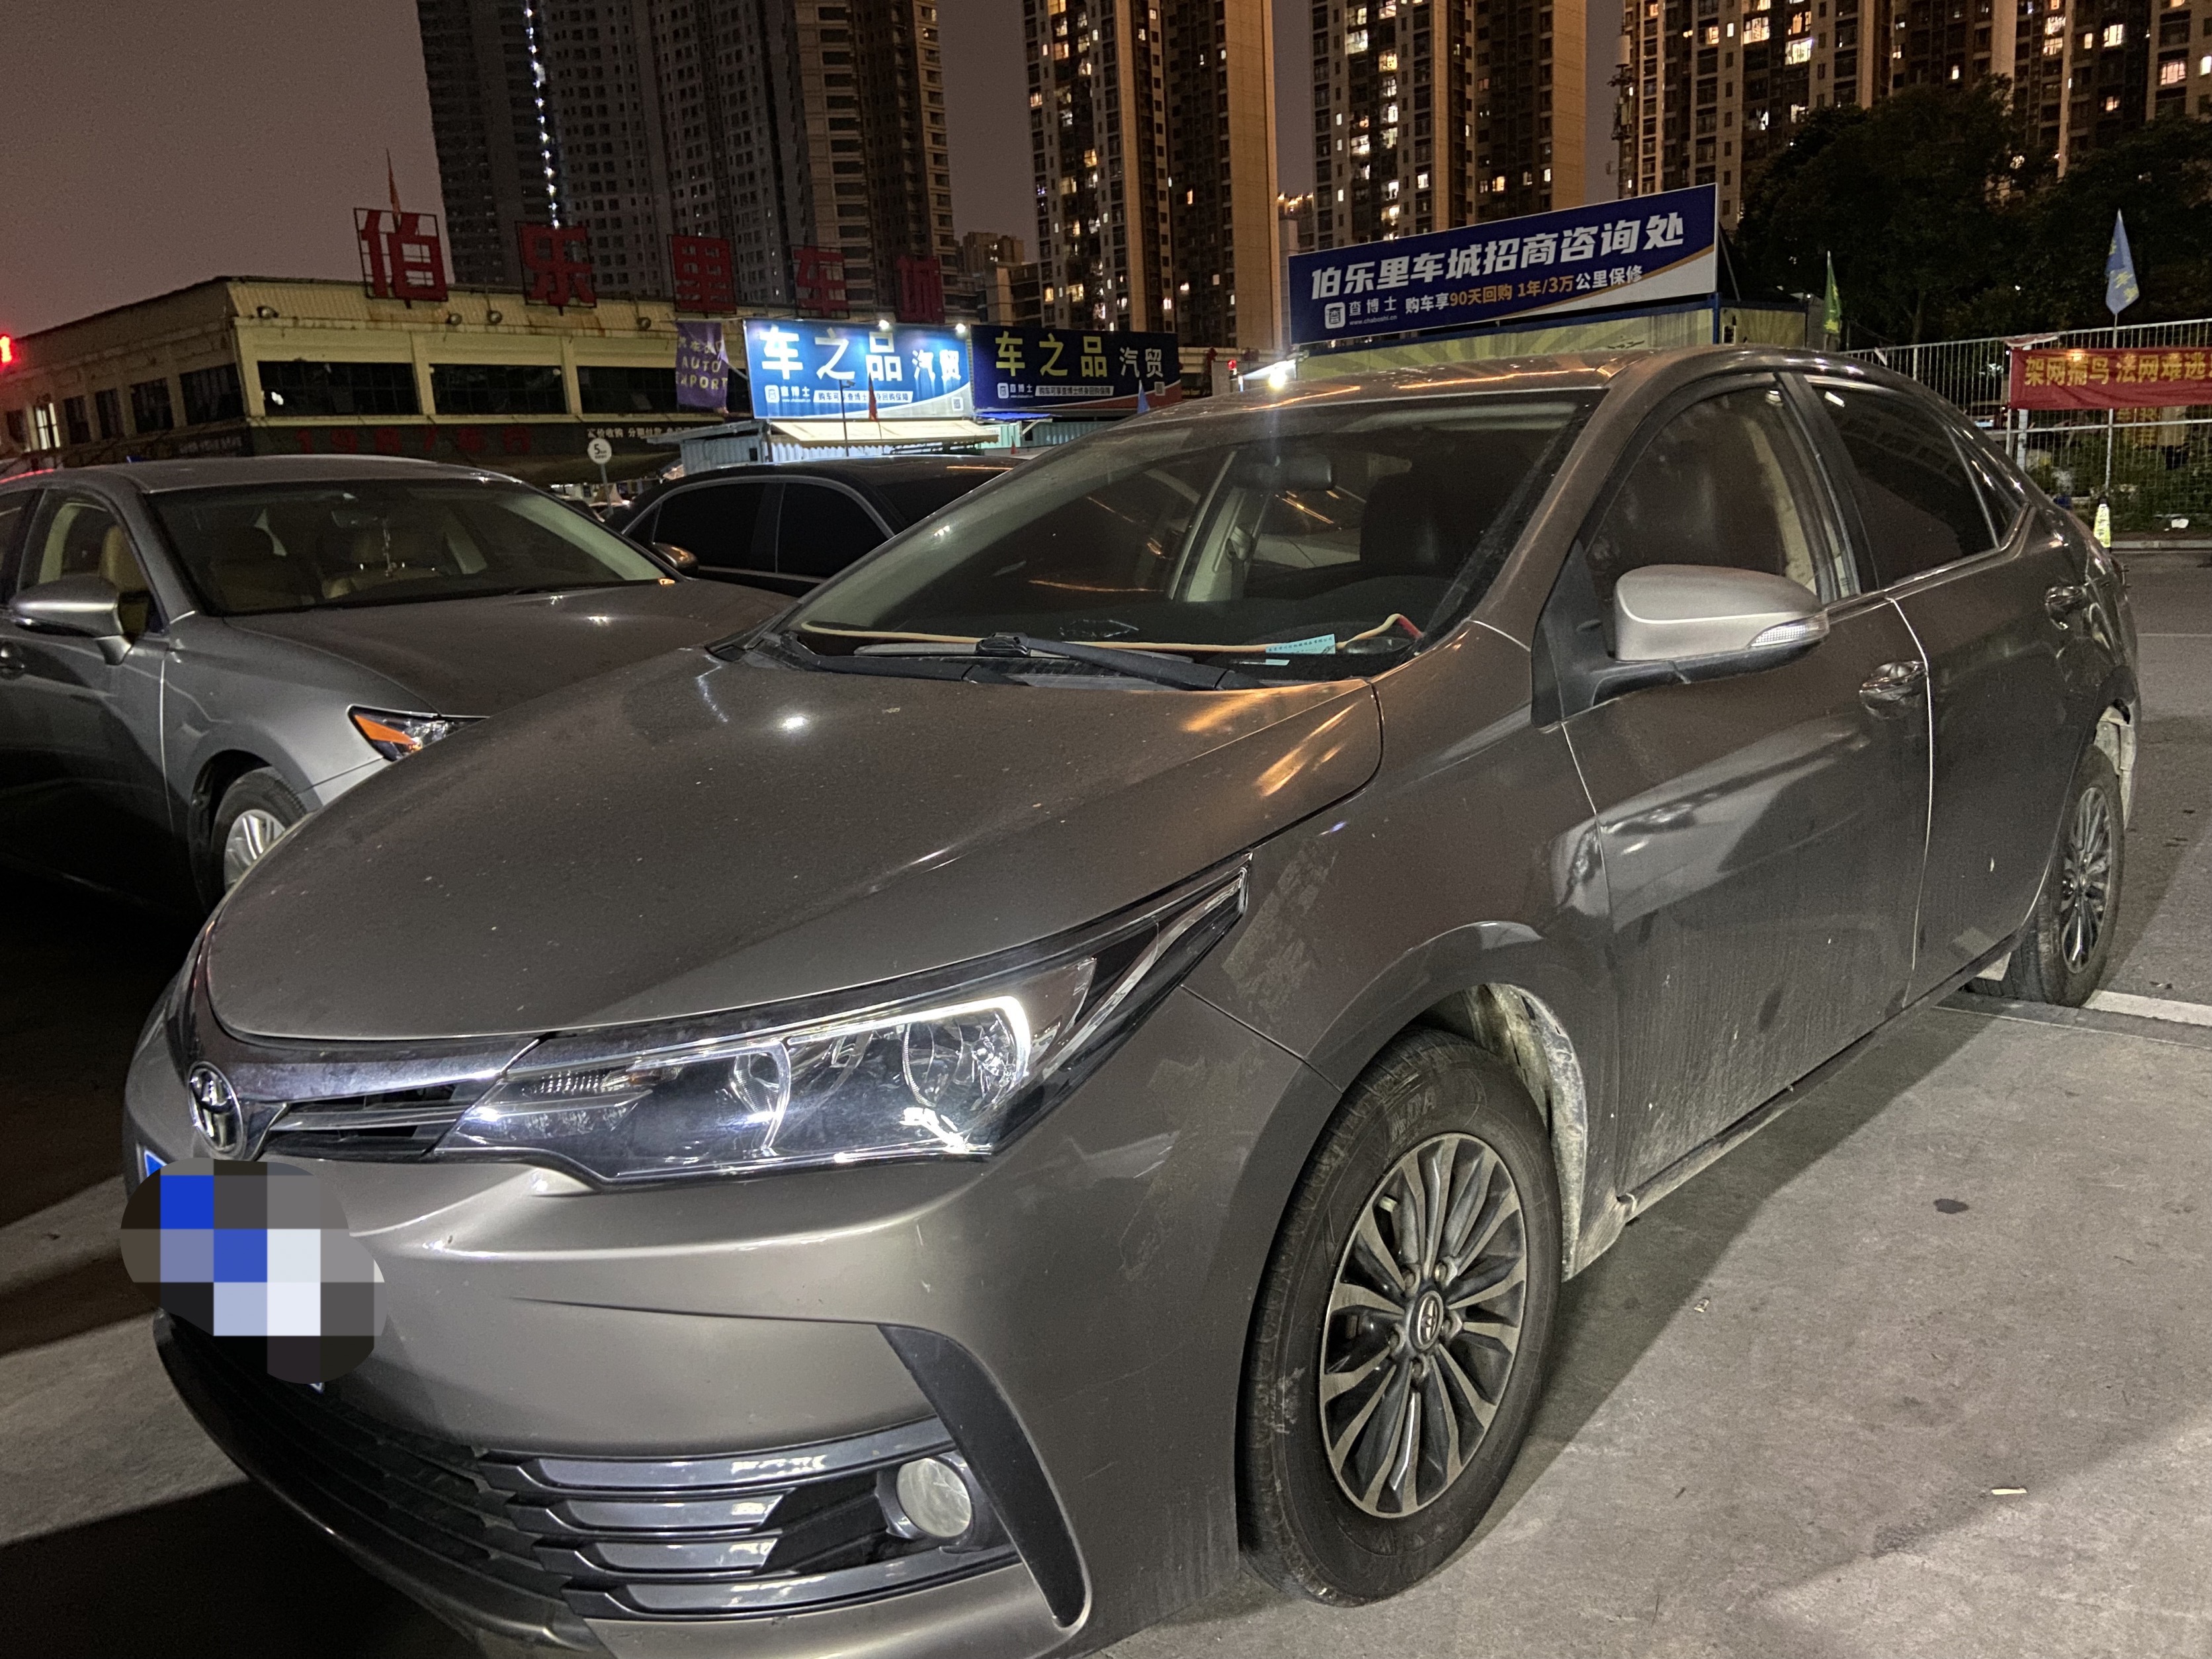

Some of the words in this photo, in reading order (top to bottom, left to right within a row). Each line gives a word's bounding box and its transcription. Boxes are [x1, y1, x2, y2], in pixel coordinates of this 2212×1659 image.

[1310, 212, 1684, 300] 伯乐里车城招商咨询处
[1405, 284, 1512, 314] 购车享90天回购
[1517, 265, 1643, 298] 1年/3万公里保修
[1348, 296, 1398, 317] 查博士
[1349, 314, 1398, 326] www.chaboshi.cn
[681, 356, 722, 373] AUTO
[759, 326, 903, 382] 车之品
[912, 349, 962, 380] 汽贸
[995, 331, 1108, 378] 车之品
[1119, 347, 1164, 378] 汽贸
[2024, 353, 2109, 386] 架网捕鸟
[818, 392, 909, 402] 购车可查博士身回购保障
